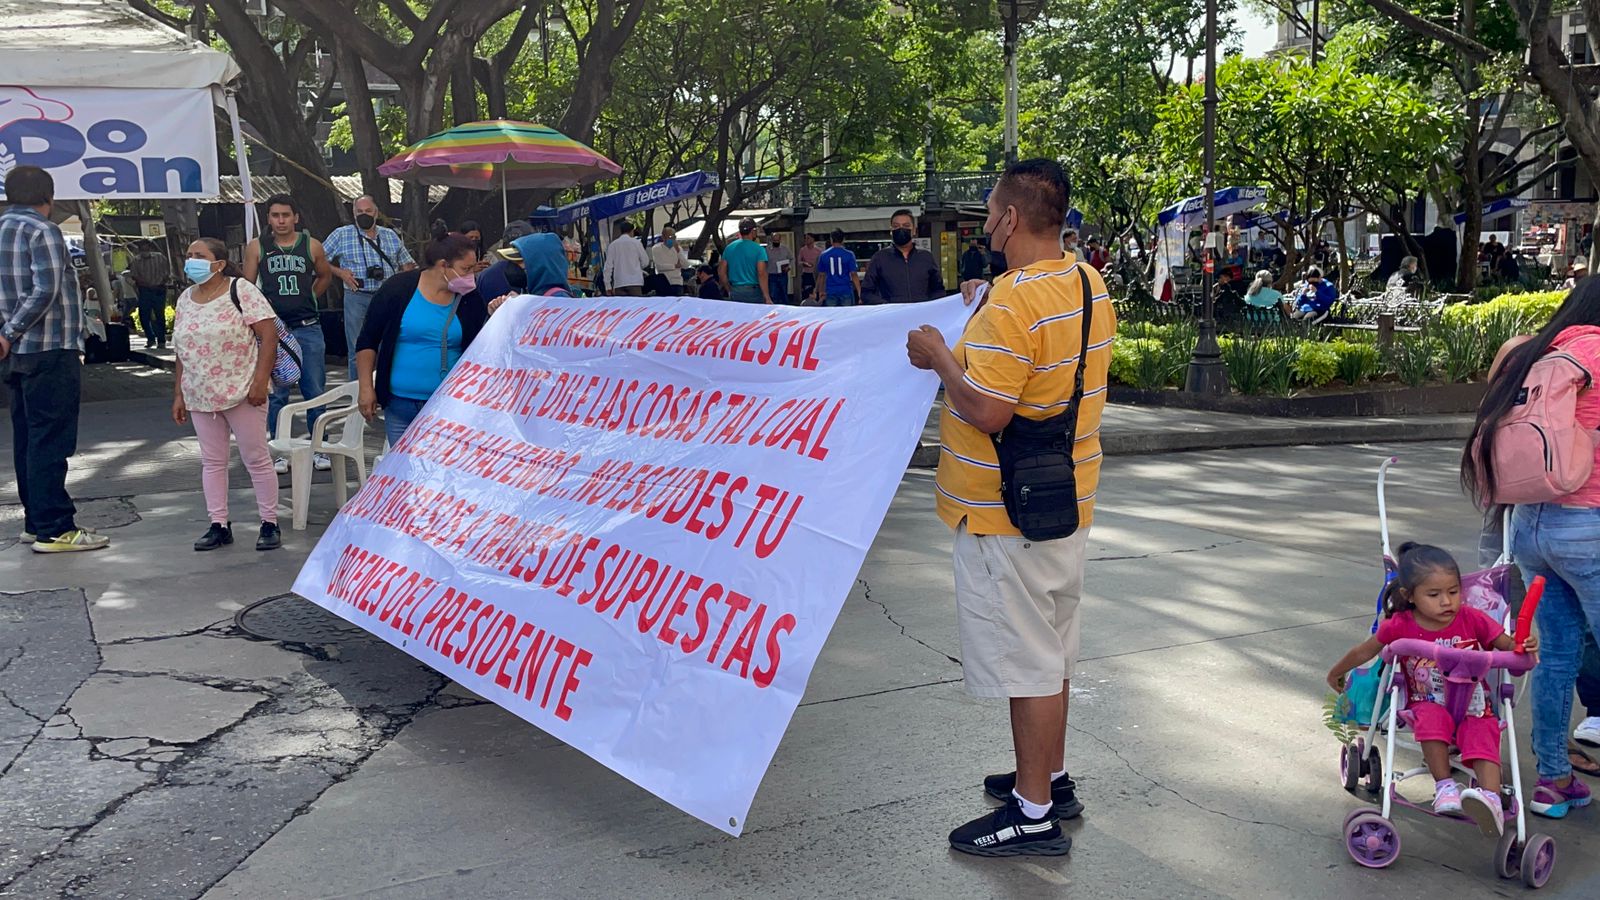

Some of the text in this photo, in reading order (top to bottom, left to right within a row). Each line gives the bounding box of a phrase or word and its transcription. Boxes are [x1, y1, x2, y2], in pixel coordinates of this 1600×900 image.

[636, 184, 670, 204] telcel
[267, 254, 306, 273] CELTICS
[829, 256, 842, 276] 11
[278, 275, 299, 295] 11
[541, 307, 581, 347] LA
[621, 312, 679, 351] NO
[779, 319, 832, 371] AL
[536, 372, 600, 424] DILE
[582, 378, 639, 432] LAS
[626, 382, 722, 443] COSAS
[703, 393, 770, 444] TAL
[748, 397, 846, 461] CUAL
[569, 459, 633, 505] NO
[604, 464, 748, 540] ESCUDES
[734, 484, 804, 558] TU
[449, 510, 491, 553] A
[541, 533, 600, 597] DE
[576, 544, 796, 688] SUPUESTAS
[379, 572, 439, 636] DEL
[414, 587, 593, 721] PRESIDENTE
[973, 833, 995, 846] YEEZY
